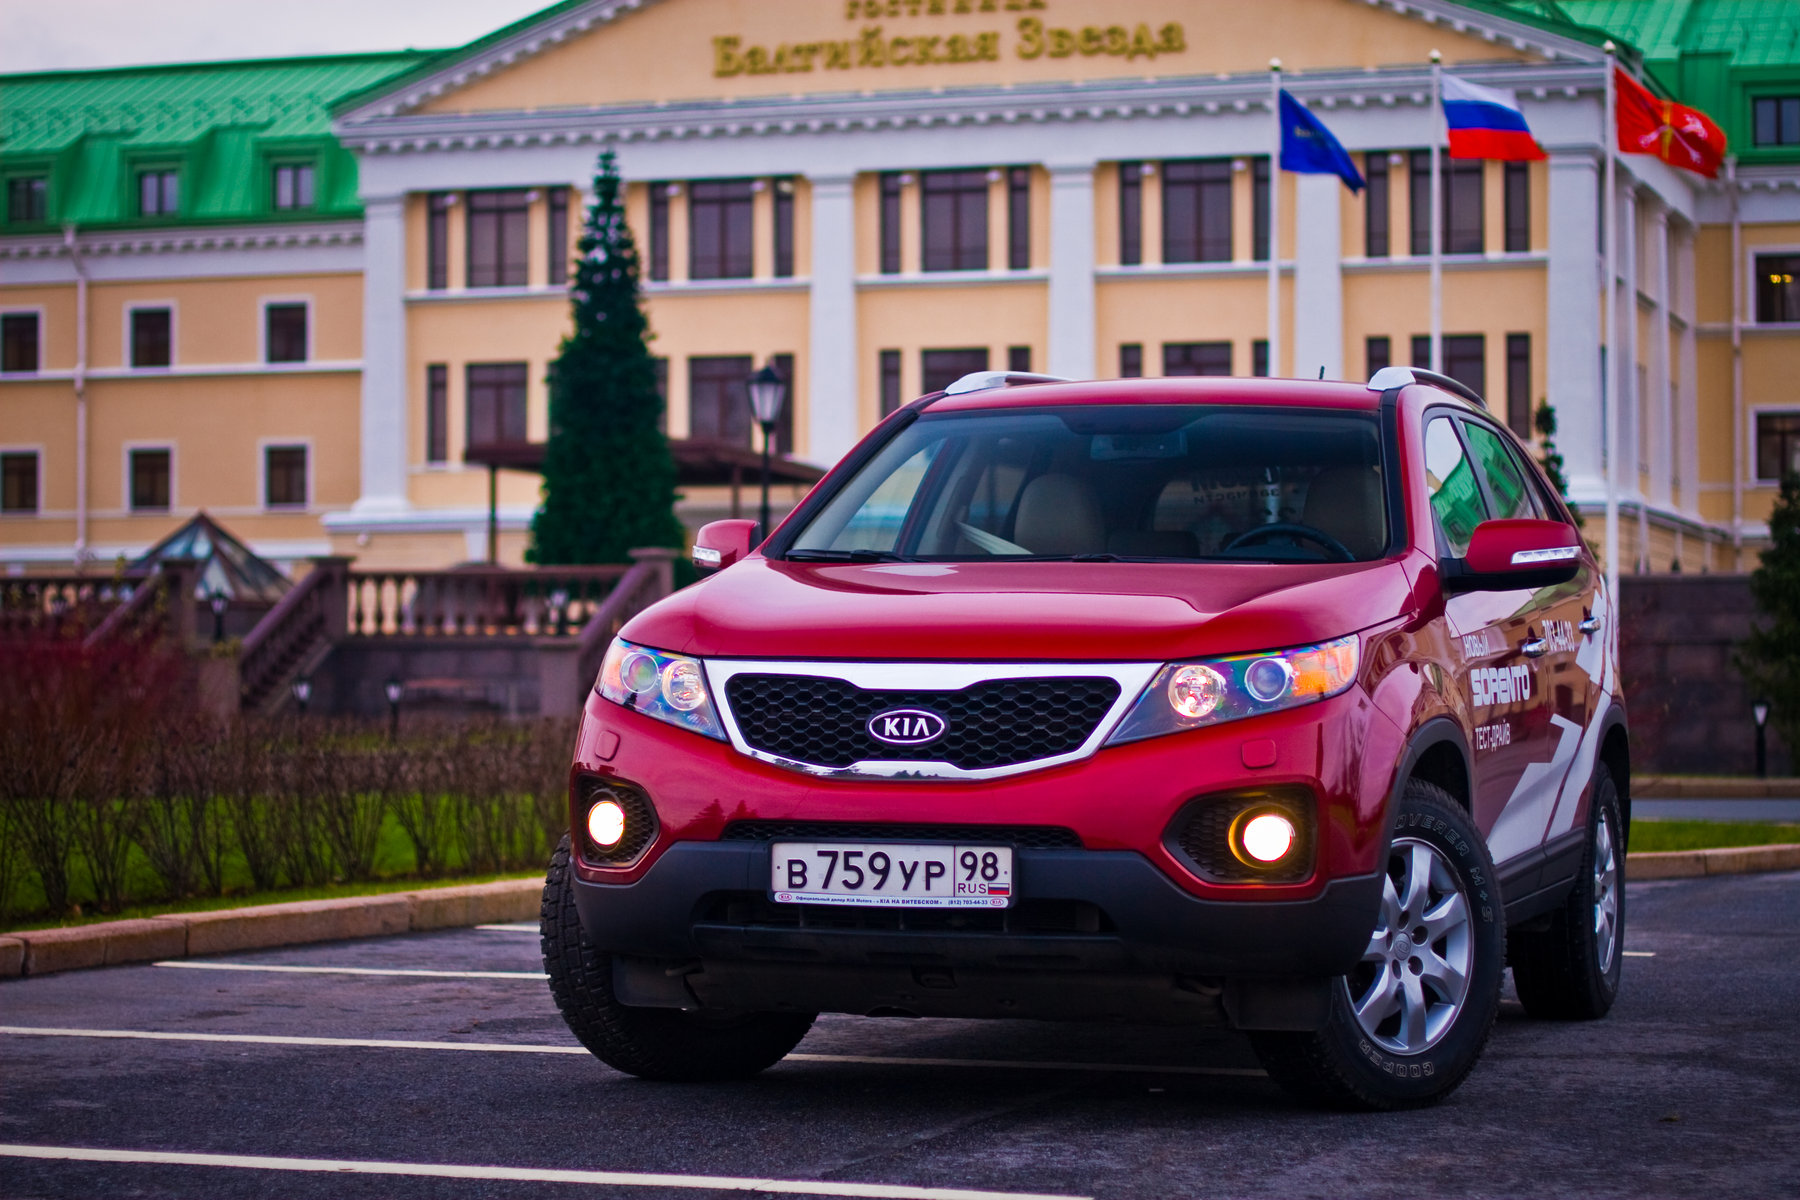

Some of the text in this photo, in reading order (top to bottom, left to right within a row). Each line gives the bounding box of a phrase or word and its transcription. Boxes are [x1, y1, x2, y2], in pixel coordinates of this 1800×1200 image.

[713, 17, 1187, 77] Балтийская Звезда
[1462, 630, 1490, 657] НОВЫЙ
[1470, 664, 1530, 707] SORENTO
[884, 717, 930, 737] KIA
[1475, 719, 1511, 752] ТЕСТ-ДРАЙВ
[959, 851, 999, 882] 98
[957, 883, 987, 894] RUS
[1359, 1039, 1435, 1078] COOPER
